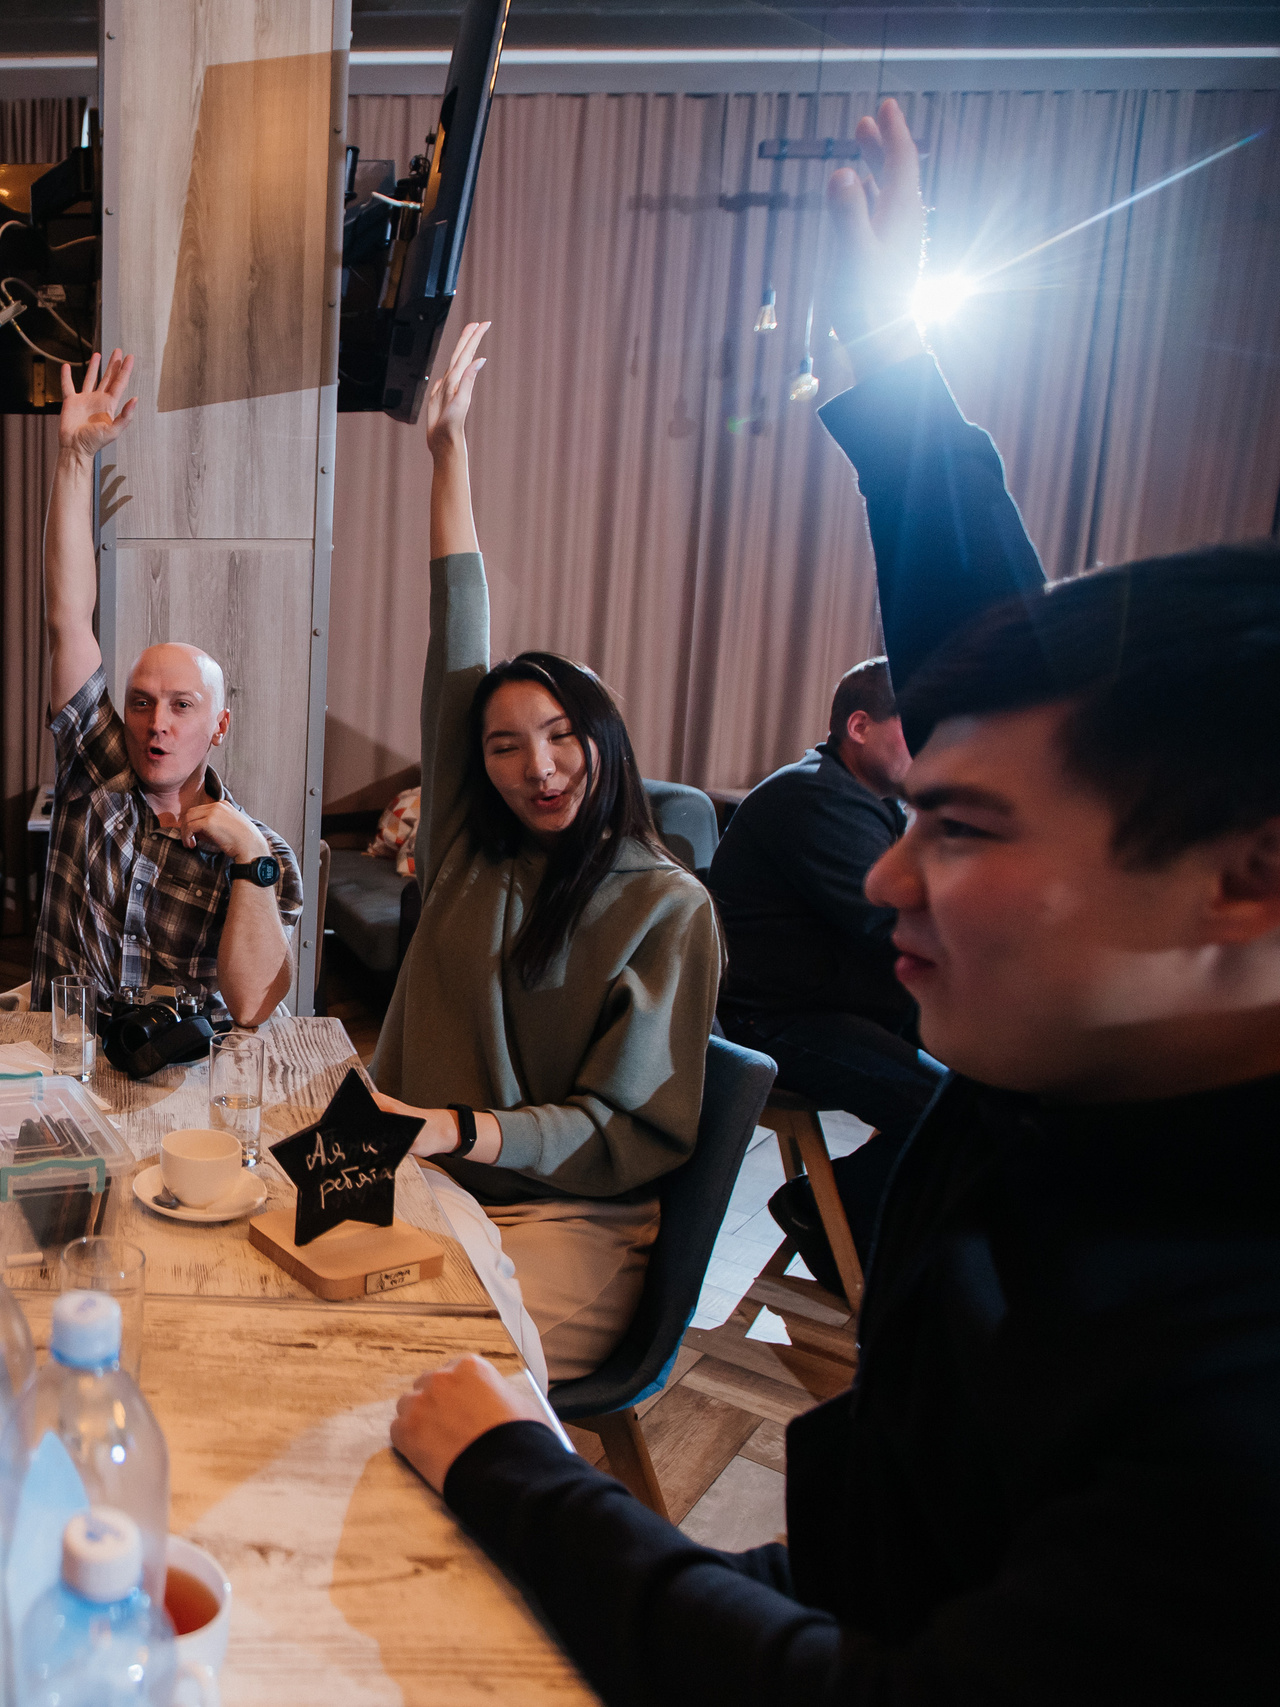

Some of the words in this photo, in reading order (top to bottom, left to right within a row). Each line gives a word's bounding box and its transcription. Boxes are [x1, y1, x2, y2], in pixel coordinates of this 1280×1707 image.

[305, 1131, 346, 1171] Ая
[362, 1141, 379, 1155] и
[319, 1165, 395, 1210] ребята
